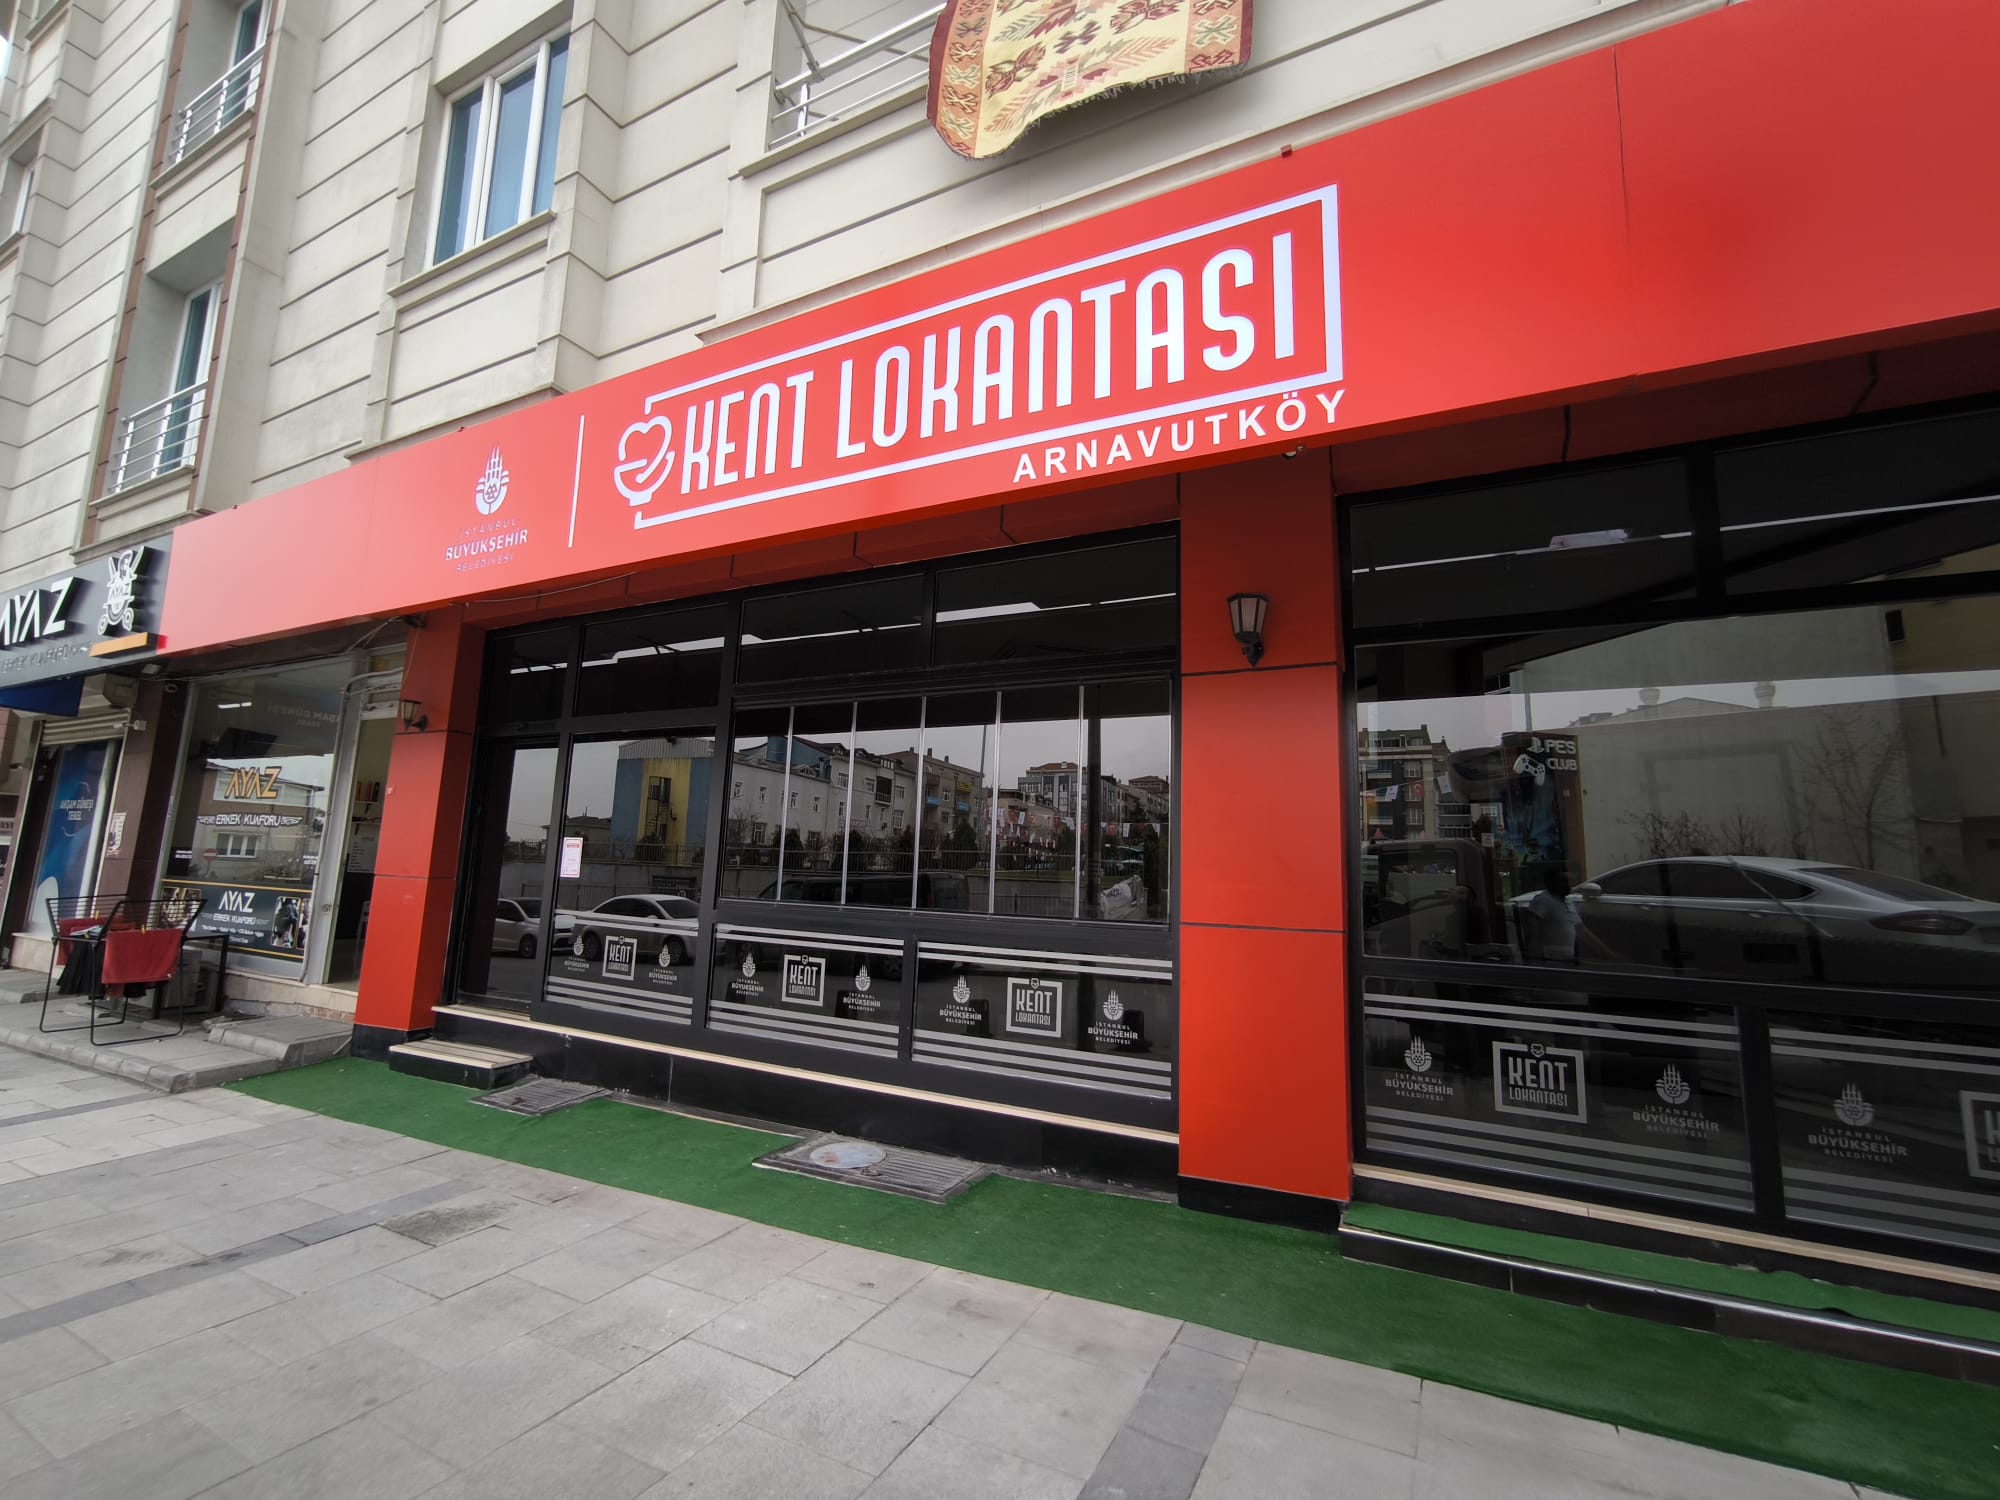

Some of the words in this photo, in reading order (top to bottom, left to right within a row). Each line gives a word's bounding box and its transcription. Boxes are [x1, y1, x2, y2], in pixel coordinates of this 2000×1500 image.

[681, 372, 814, 495] KENT
[835, 232, 1295, 458] LOKANTASI
[1013, 390, 1346, 483] ARNAVUTKÖY
[1544, 739, 1577, 755] PES
[1546, 757, 1578, 771] CLUB
[225, 767, 282, 798] AYAZ
[216, 814, 241, 826] ERKEK
[218, 890, 256, 912] AYAZ
[609, 944, 632, 963] KENT
[790, 964, 818, 986] KENT
[1016, 988, 1053, 1014] KENT
[1015, 1012, 1051, 1026] LOKANTASI
[1508, 1056, 1568, 1091] KENT
[1508, 1086, 1568, 1107] LOKANTASI
